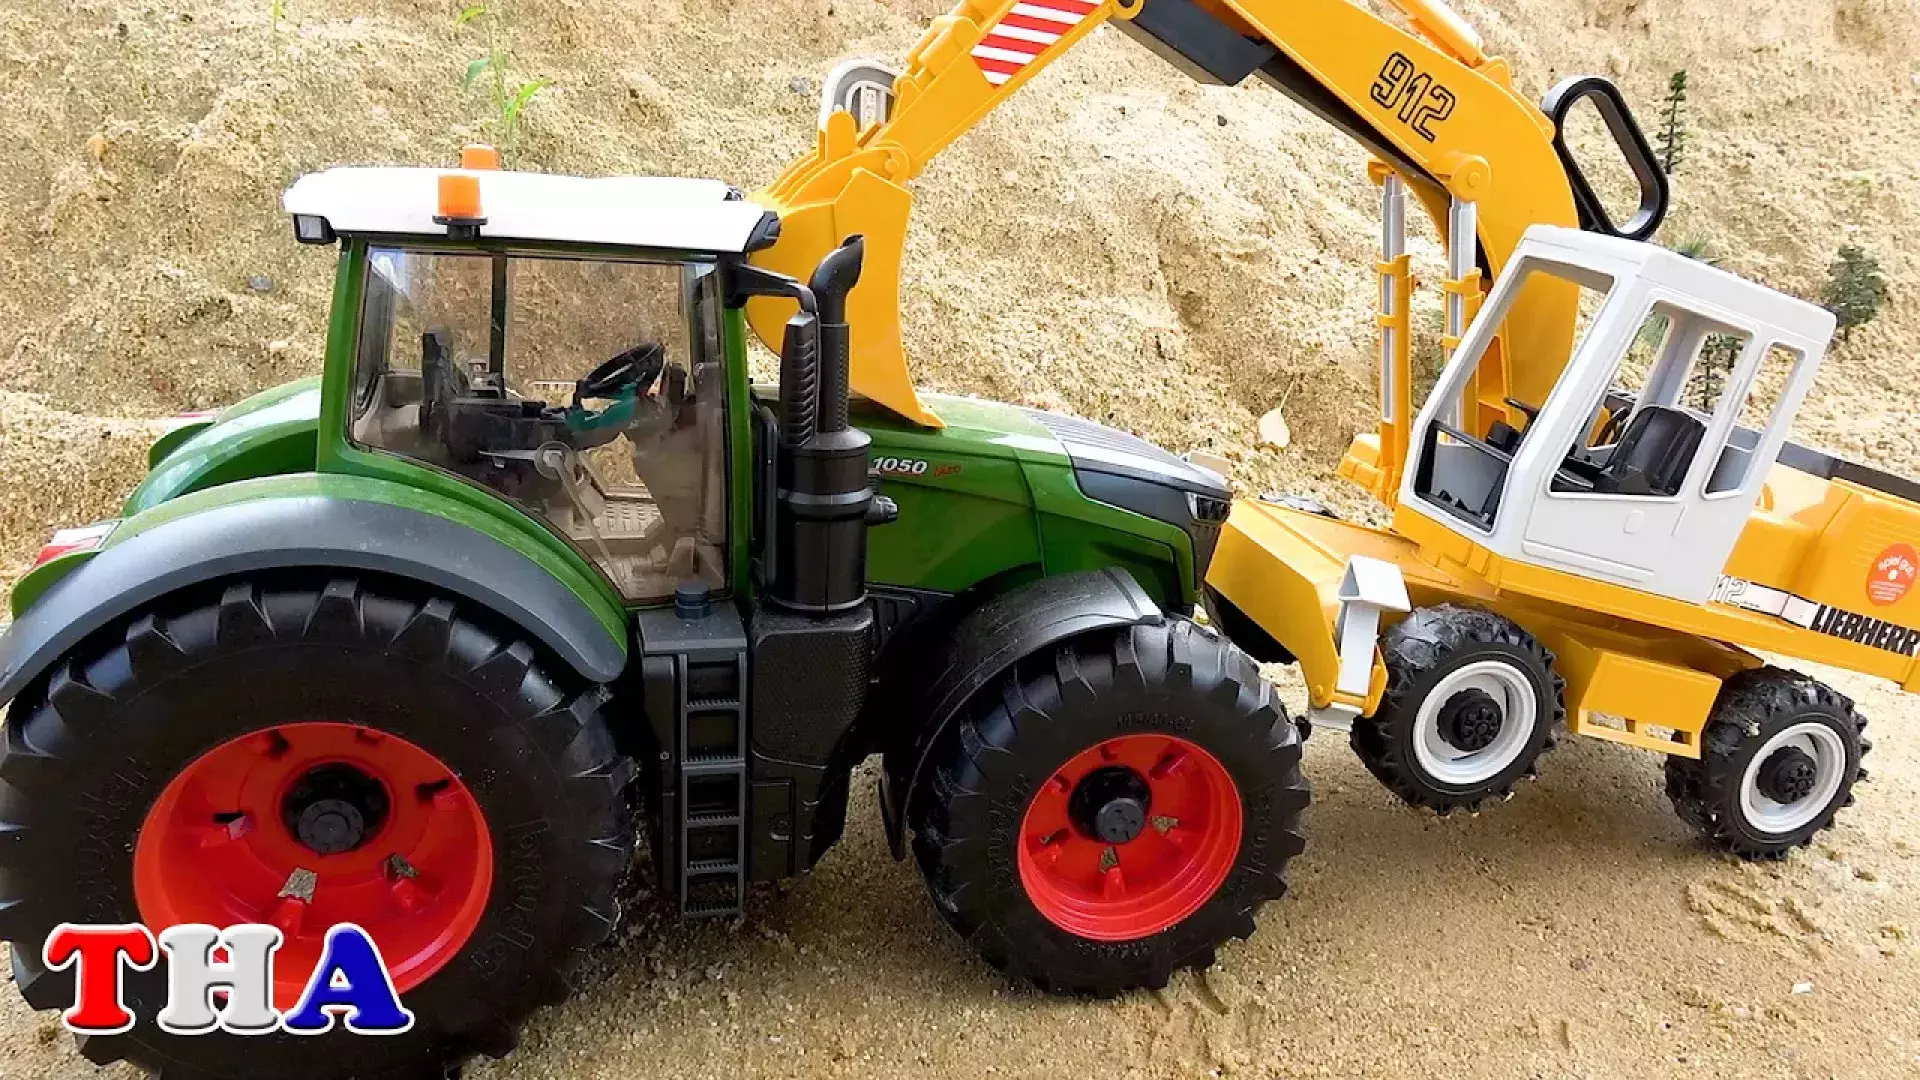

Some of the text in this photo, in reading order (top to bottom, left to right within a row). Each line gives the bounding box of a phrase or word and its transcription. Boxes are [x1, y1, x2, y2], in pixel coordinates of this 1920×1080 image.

[1370, 51, 1456, 143] 912
[873, 457, 928, 475] 1050
[1706, 575, 1748, 608] 12
[1809, 603, 1920, 658] LIEBHERR
